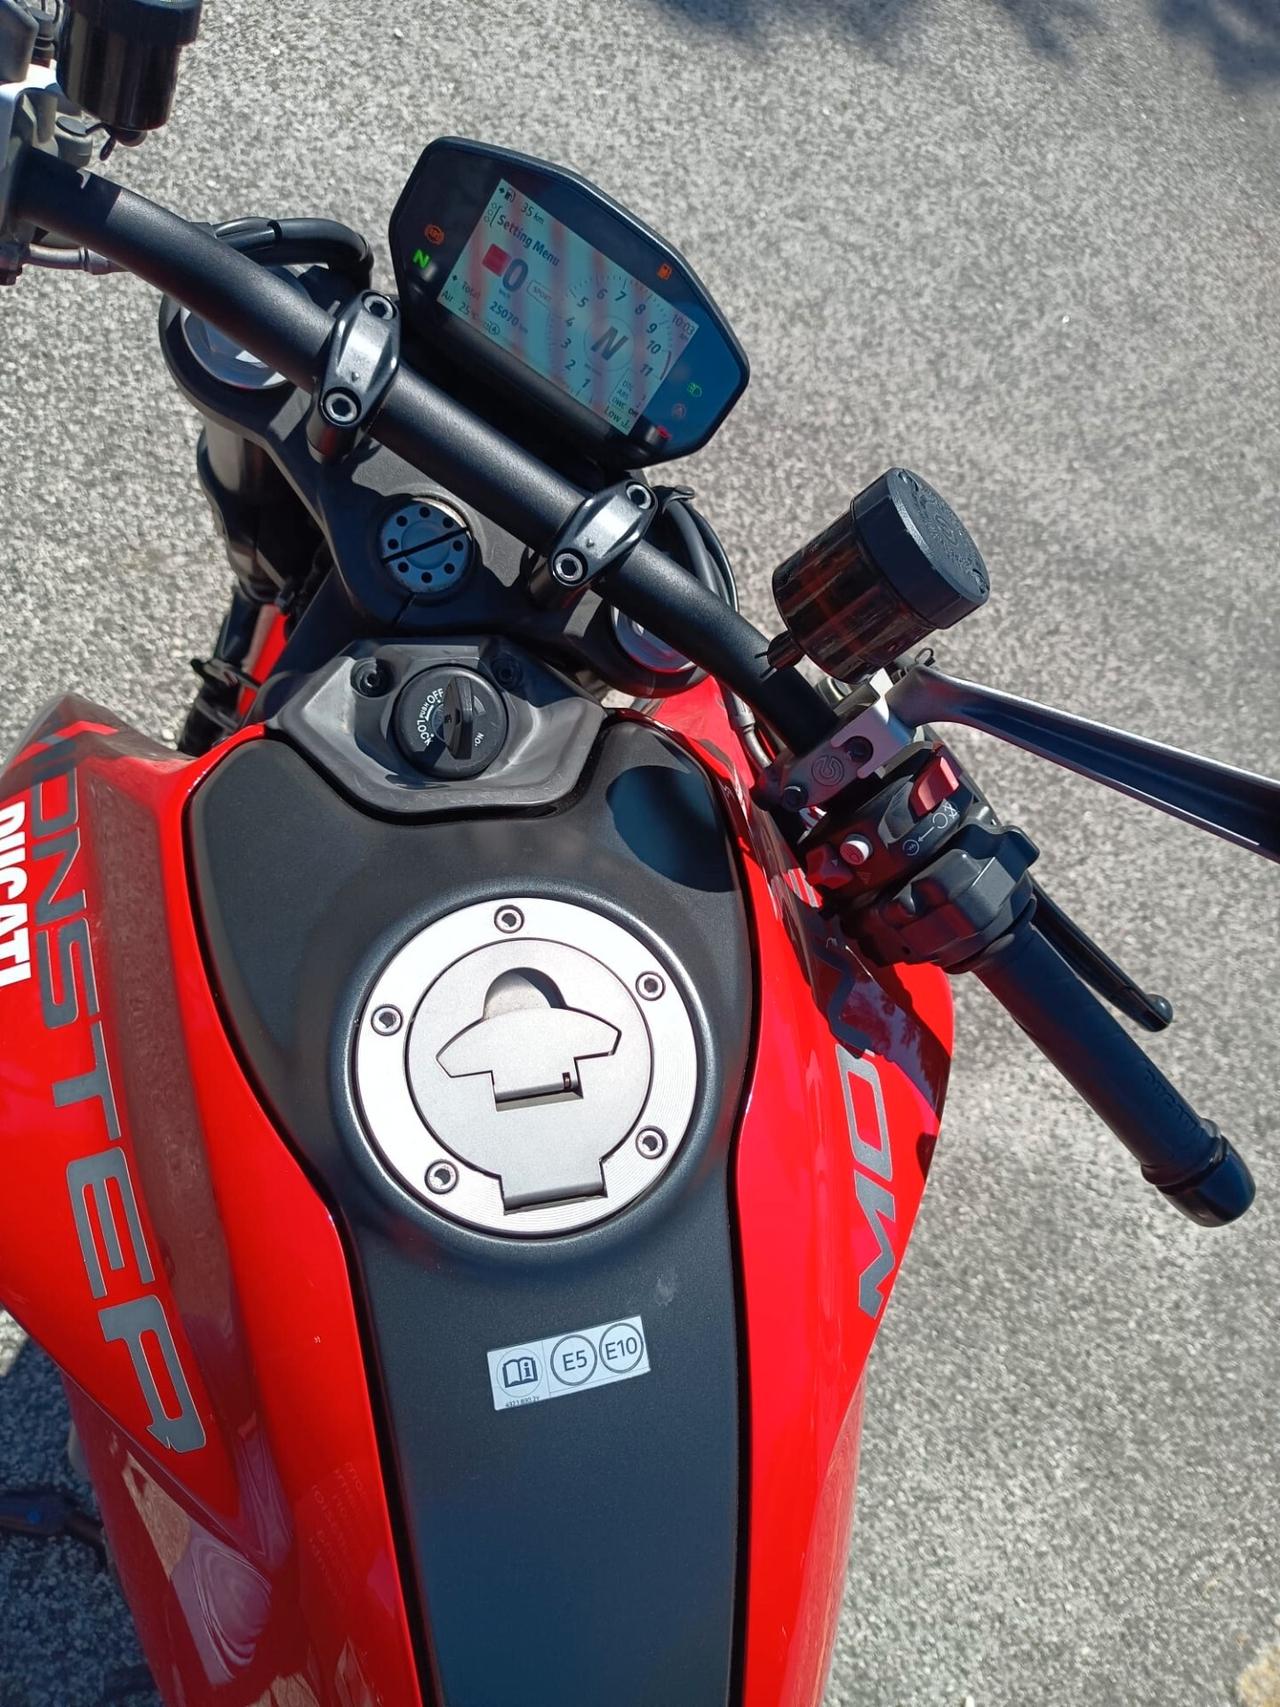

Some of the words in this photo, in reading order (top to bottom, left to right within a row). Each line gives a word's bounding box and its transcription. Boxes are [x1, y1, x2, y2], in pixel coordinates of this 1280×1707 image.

[521, 203, 533, 216] 35
[533, 213, 545, 224] km
[497, 215, 533, 248] Setting
[532, 241, 560, 266] Menu
[413, 249, 429, 269] N
[502, 258, 529, 293] 0
[597, 288, 608, 300] 6
[615, 291, 627, 301] 7
[459, 302, 470, 316] 25
[577, 297, 588, 308] 5
[635, 304, 646, 315] 8
[489, 301, 519, 327] 25070
[566, 316, 576, 327] 4
[646, 323, 657, 334] 9
[561, 338, 571, 349] 3
[591, 326, 629, 361] N
[647, 341, 662, 354] 10
[565, 359, 576, 371] 2
[640, 363, 654, 377] 11
[582, 378, 591, 389] 1
[604, 405, 621, 423] Low
[427, 688, 444, 704] OFF
[420, 702, 429, 718] PUSH
[417, 719, 432, 746] LOCK
[475, 732, 485, 745] ON
[562, 1350, 588, 1372] E5
[605, 1336, 638, 1361] E10
